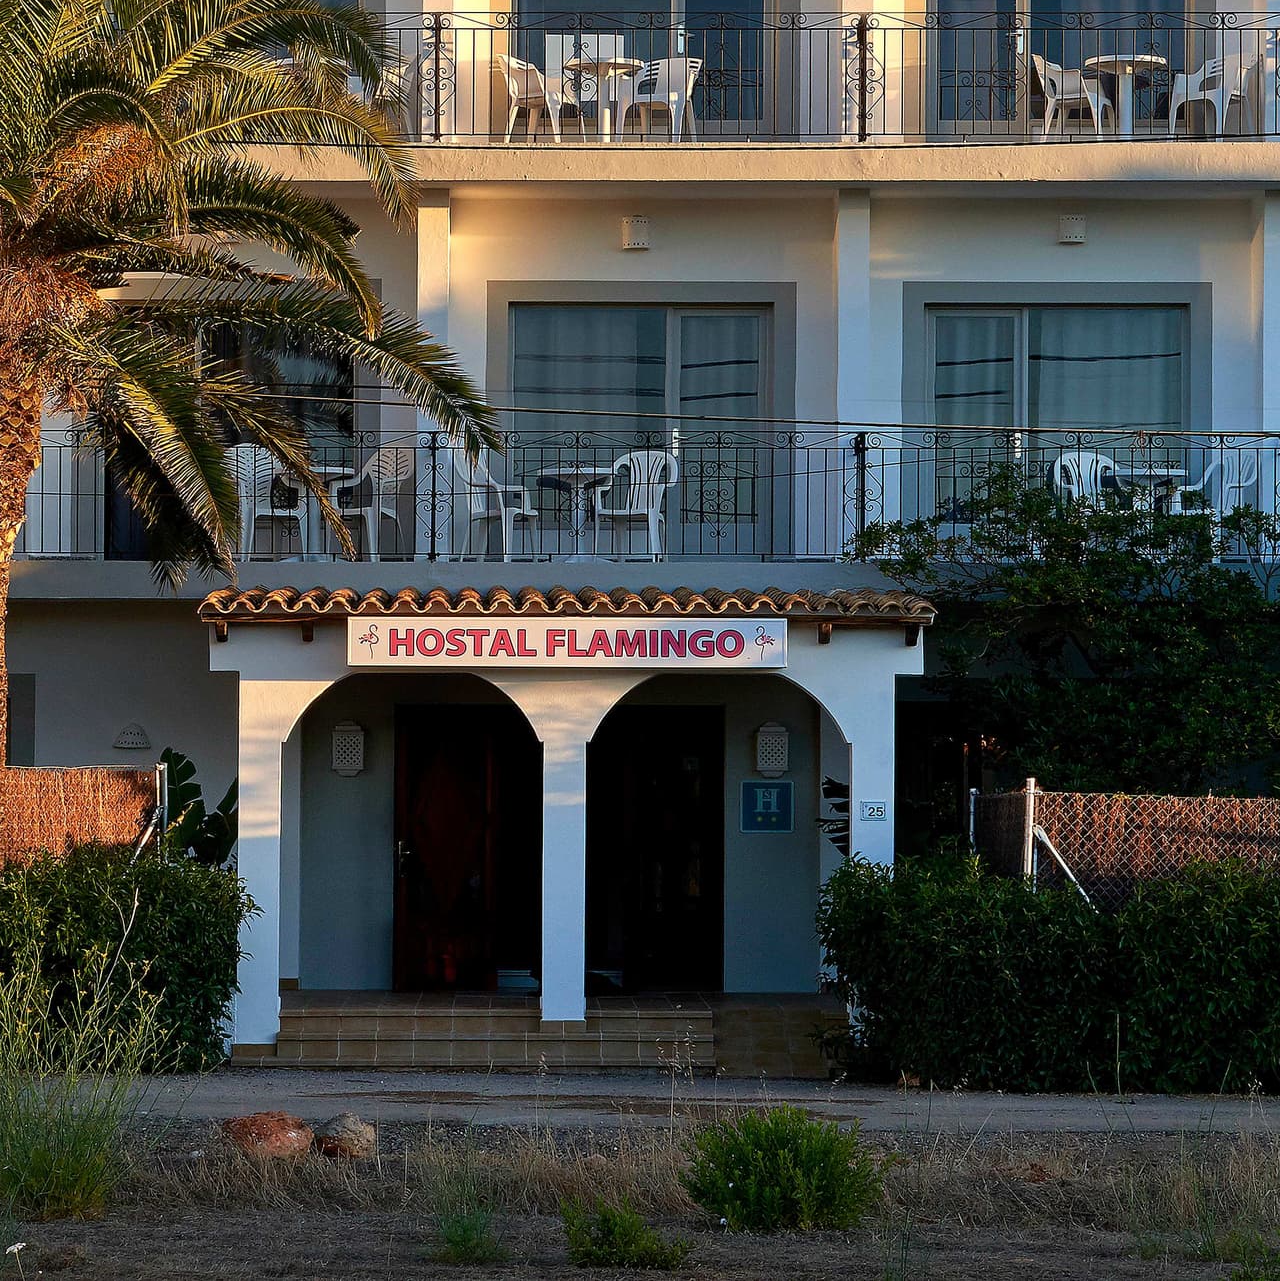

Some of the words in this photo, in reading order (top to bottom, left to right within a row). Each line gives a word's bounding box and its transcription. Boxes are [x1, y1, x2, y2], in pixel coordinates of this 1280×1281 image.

[389, 628, 537, 657] HOSTAL
[546, 629, 745, 658] FLAMINGO
[868, 806, 884, 817] 25
